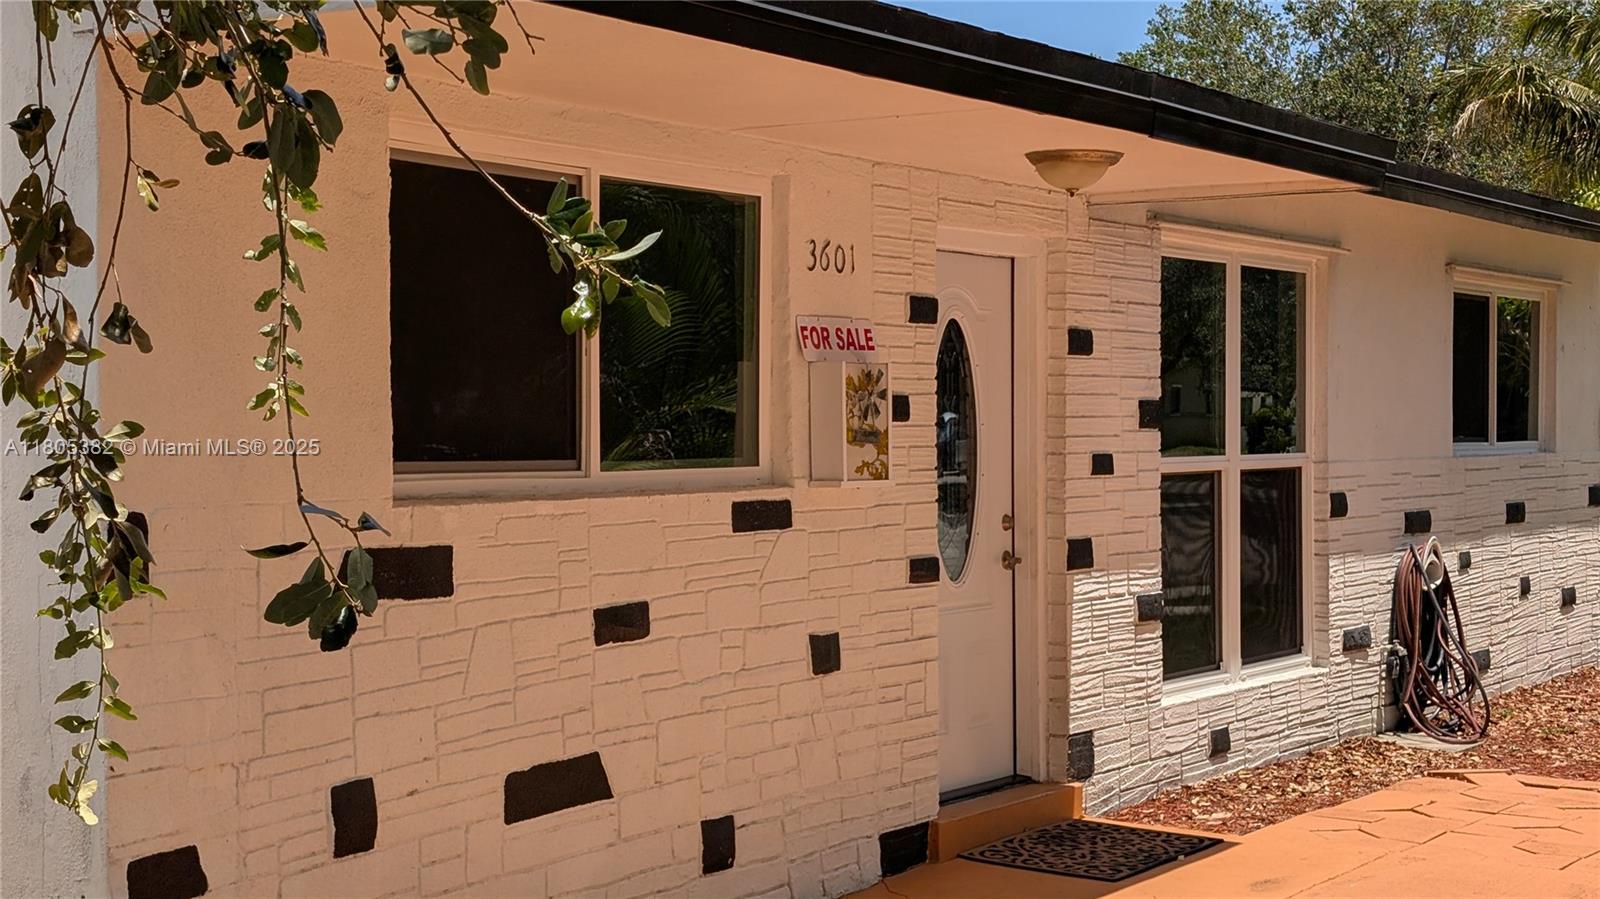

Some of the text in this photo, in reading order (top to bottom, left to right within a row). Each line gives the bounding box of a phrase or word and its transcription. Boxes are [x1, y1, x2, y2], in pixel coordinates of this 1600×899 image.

[806, 238, 855, 274] 3601
[800, 325, 876, 351] FOR SALE
